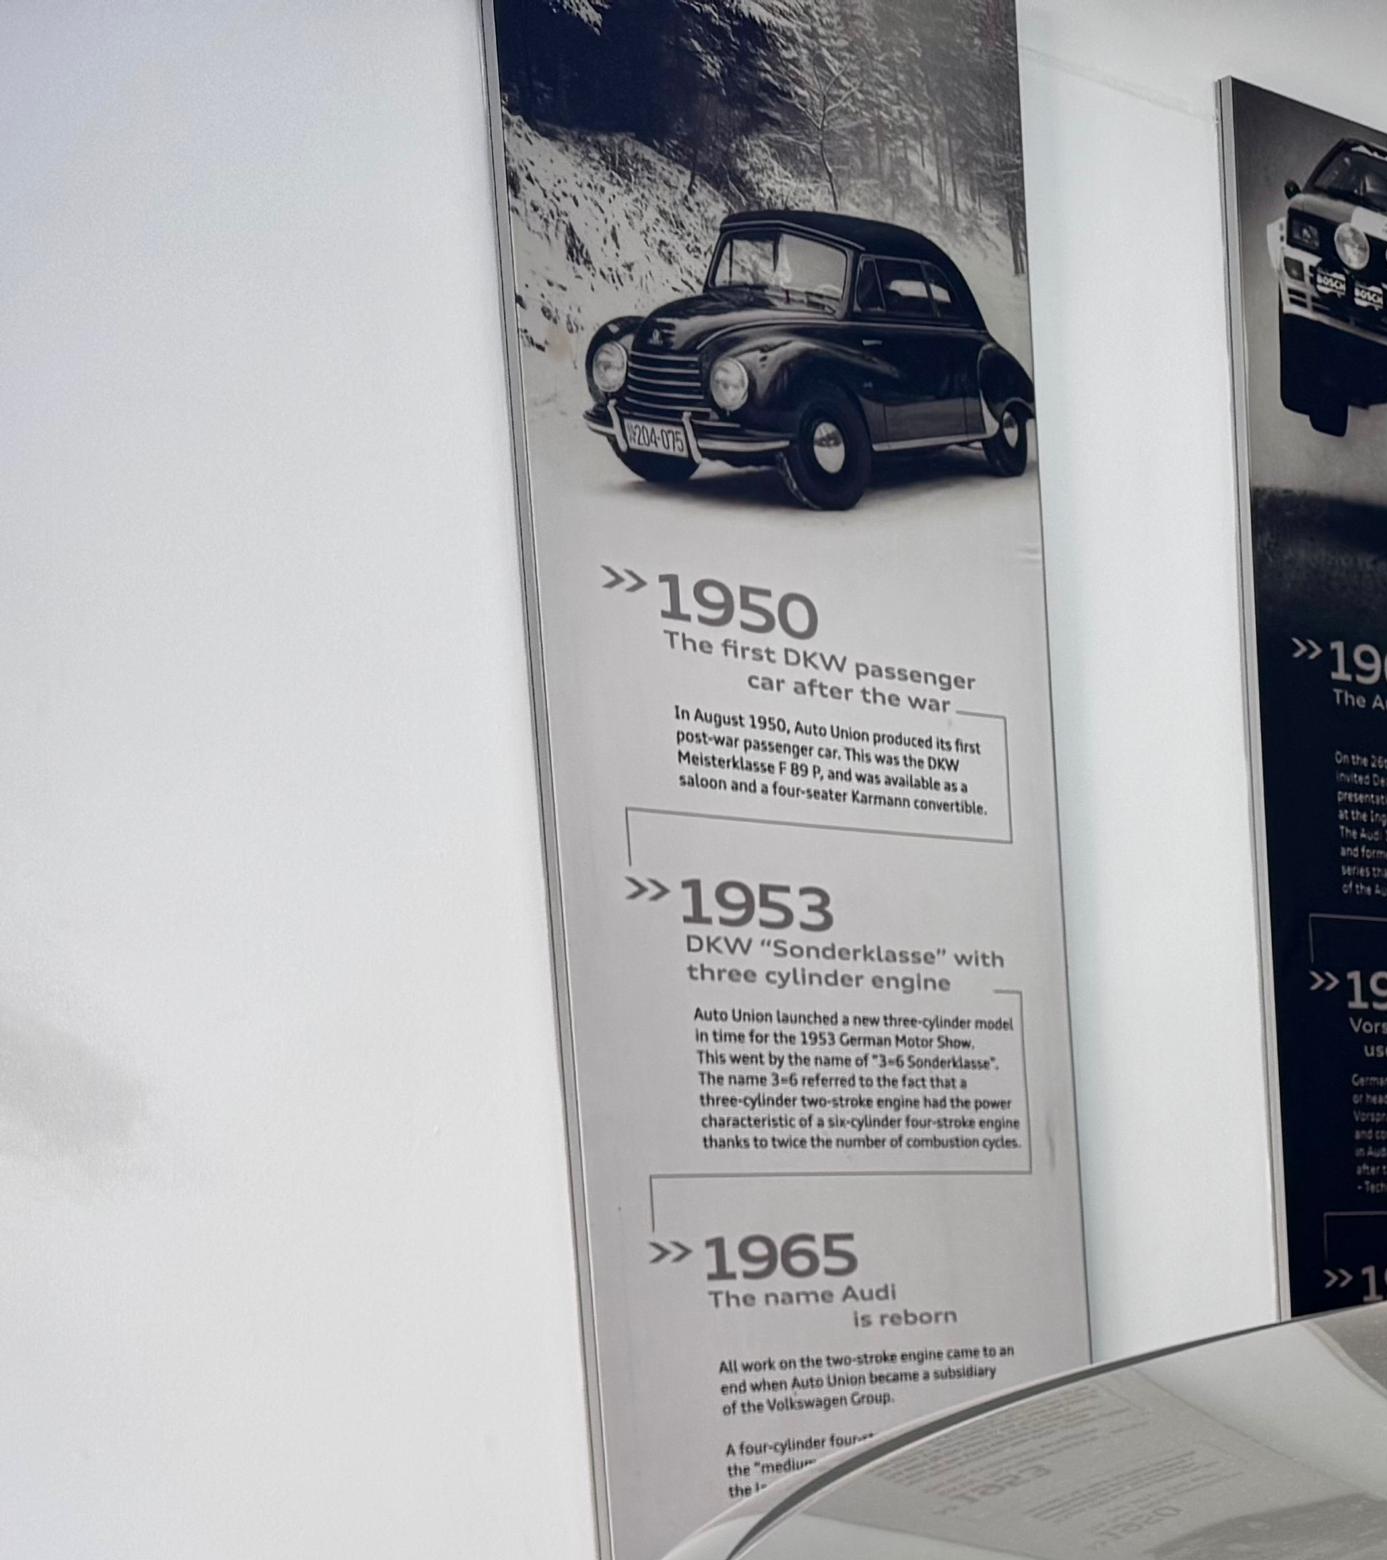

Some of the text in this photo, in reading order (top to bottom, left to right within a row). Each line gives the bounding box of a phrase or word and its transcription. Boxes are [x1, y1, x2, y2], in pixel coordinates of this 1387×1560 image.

[658, 573, 819, 640] 1950
[664, 629, 976, 691] The first DKW passenger
[747, 675, 951, 713] car after the war
[1333, 688, 1366, 708] The
[674, 705, 981, 755] In August 1950, Auto Union produced its first
[676, 730, 960, 772] post-war passenger car. This was the DKW
[678, 753, 968, 794] Meisterklasse F 89 P, and was available as a
[679, 773, 987, 815] saloon and a four-seater Karmann convertible.
[680, 878, 834, 931] 1953
[686, 934, 753, 955] DKW
[954, 950, 1005, 968] with
[686, 963, 951, 994] three cylinder engine
[694, 1007, 1014, 1031] Auto Union launched a new three-cylinder model
[695, 1028, 975, 1050] in time for the 1953 German Motor Show.
[697, 1049, 726, 1065] This
[729, 1053, 765, 1066] went
[768, 1051, 785, 1069] by
[787, 1052, 811, 1067] the
[814, 1056, 852, 1068] name
[855, 1053, 868, 1068] of
[699, 1093, 1012, 1112] three-cylinder two-stroke engine had the power
[701, 1113, 1020, 1133] characteristic of a six-cylinder four-stroke engine
[702, 1134, 1021, 1152] thanks to twice the number of combustion cycles.
[704, 1233, 858, 1281] 1965
[707, 1283, 896, 1308] The name Audi
[853, 1309, 958, 1328] is reborn
[720, 1365, 996, 1396] end when Auto Union became a subsidiary
[722, 1391, 895, 1416] of the Volkswagen Group.
